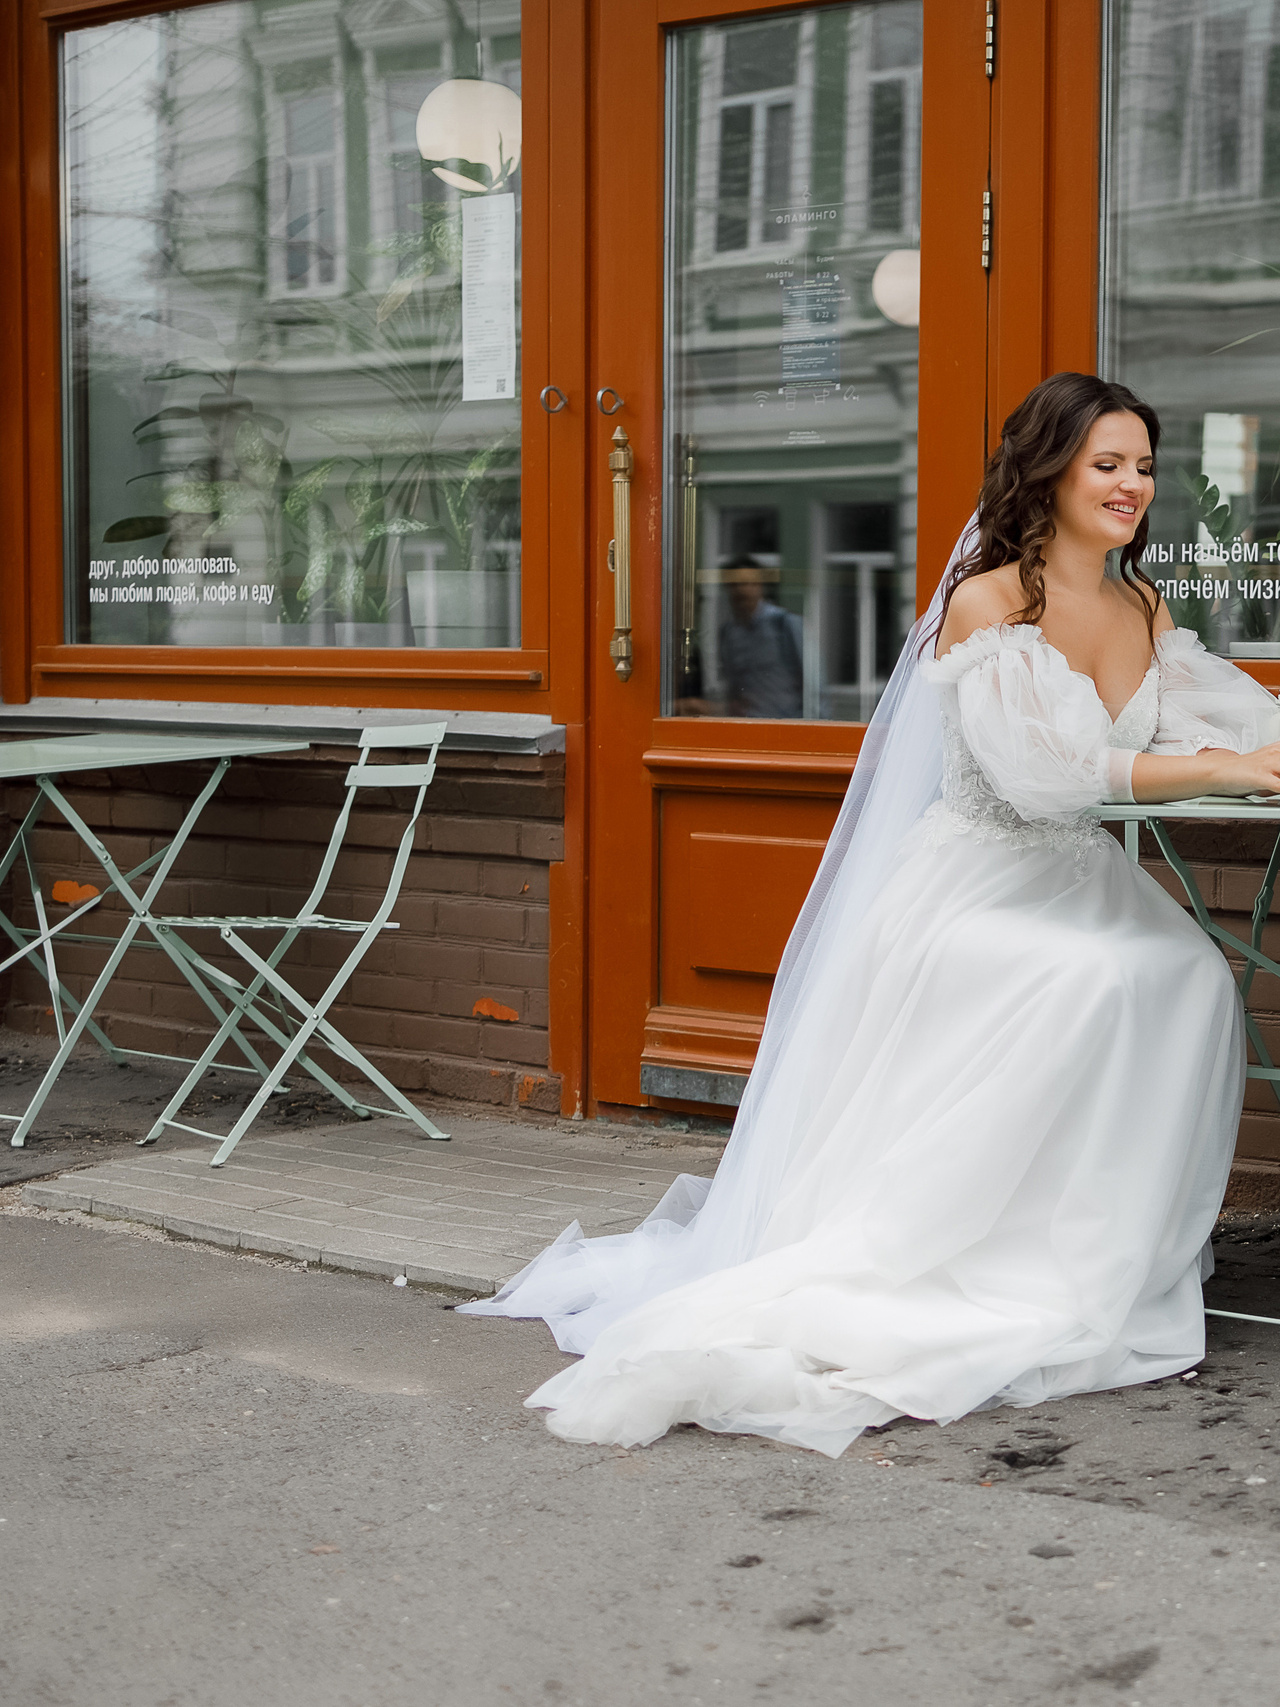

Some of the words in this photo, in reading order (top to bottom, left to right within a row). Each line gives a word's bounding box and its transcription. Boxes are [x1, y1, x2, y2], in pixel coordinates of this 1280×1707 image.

[775, 209, 837, 224] ФЛАМИНГО
[765, 270, 795, 279] РАБОТЫ
[1142, 543, 1174, 563] мы
[1181, 536, 1259, 563] нальём
[88, 558, 120, 580] друг,
[122, 555, 159, 579] добро
[162, 557, 241, 576] пожаловать,
[89, 587, 107, 603] мы
[110, 582, 153, 603] любим
[155, 582, 200, 605] людей,
[203, 581, 236, 606] кофе
[239, 584, 248, 601] и
[252, 584, 275, 605] еду
[1155, 573, 1230, 600] спечём
